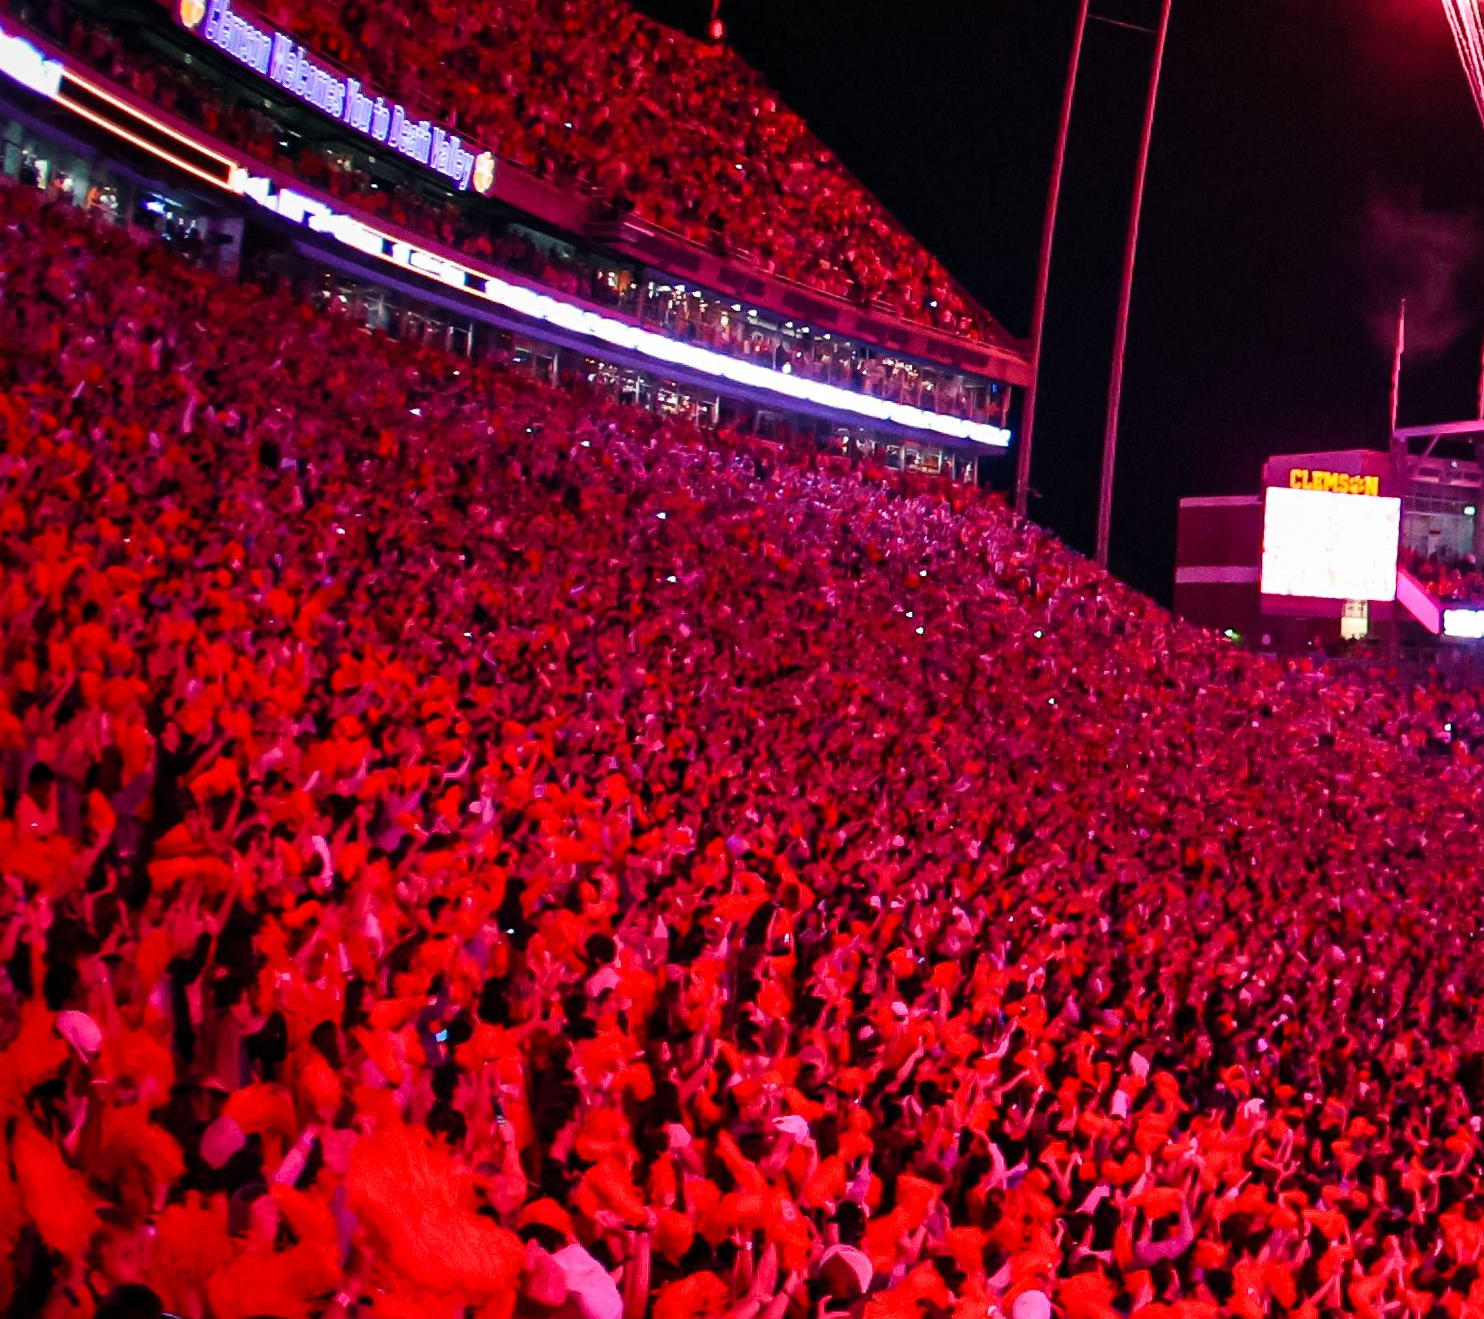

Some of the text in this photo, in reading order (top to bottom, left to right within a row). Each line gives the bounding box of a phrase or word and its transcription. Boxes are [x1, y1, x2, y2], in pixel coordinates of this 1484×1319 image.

[272, 32, 346, 118] Welcomes
[344, 78, 373, 134] You
[371, 96, 390, 141] to
[389, 104, 432, 164] Death
[431, 126, 475, 190] Valley
